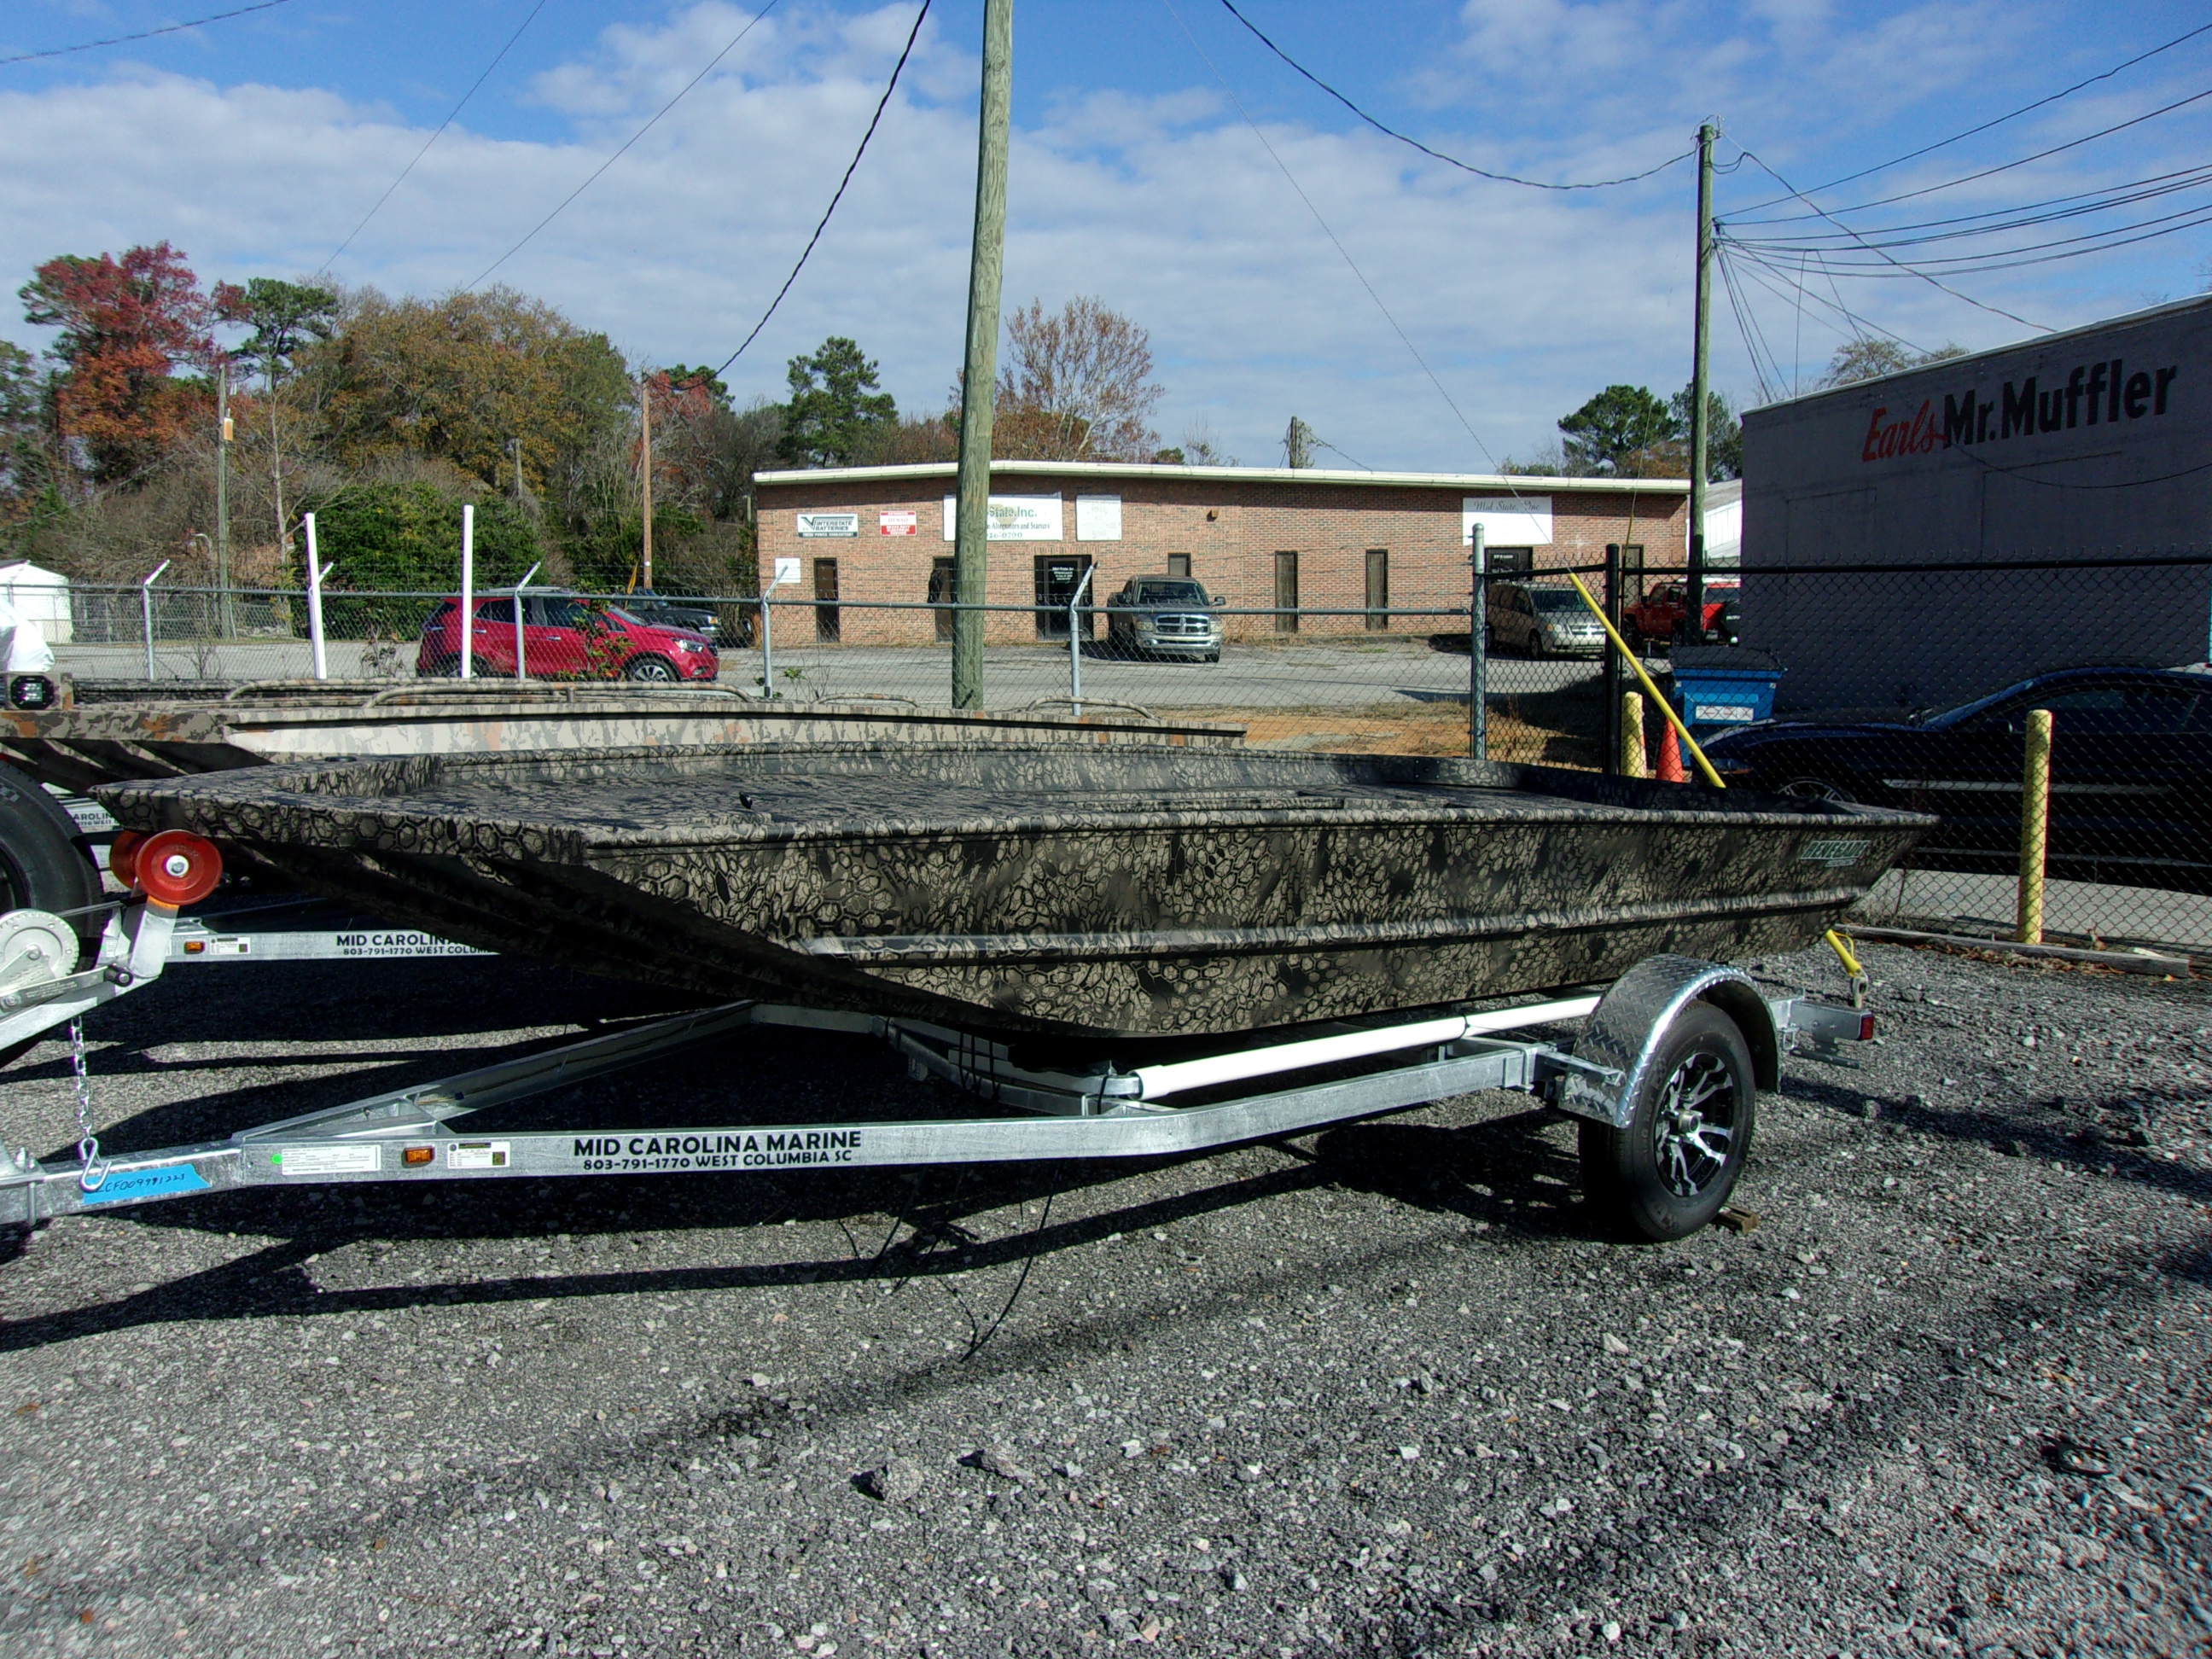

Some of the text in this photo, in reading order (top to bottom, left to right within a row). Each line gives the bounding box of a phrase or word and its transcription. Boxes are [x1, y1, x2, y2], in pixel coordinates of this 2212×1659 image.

[1474, 500, 1493, 510] Mid
[336, 934, 451, 947] MID CAROLIN
[343, 946, 413, 956] 803-791-1770
[416, 946, 448, 955] WEST
[573, 1130, 862, 1157] MID CAROLINA MARINE
[583, 1149, 853, 1171] 803-791-1770 WEST COLUMBIA SC
